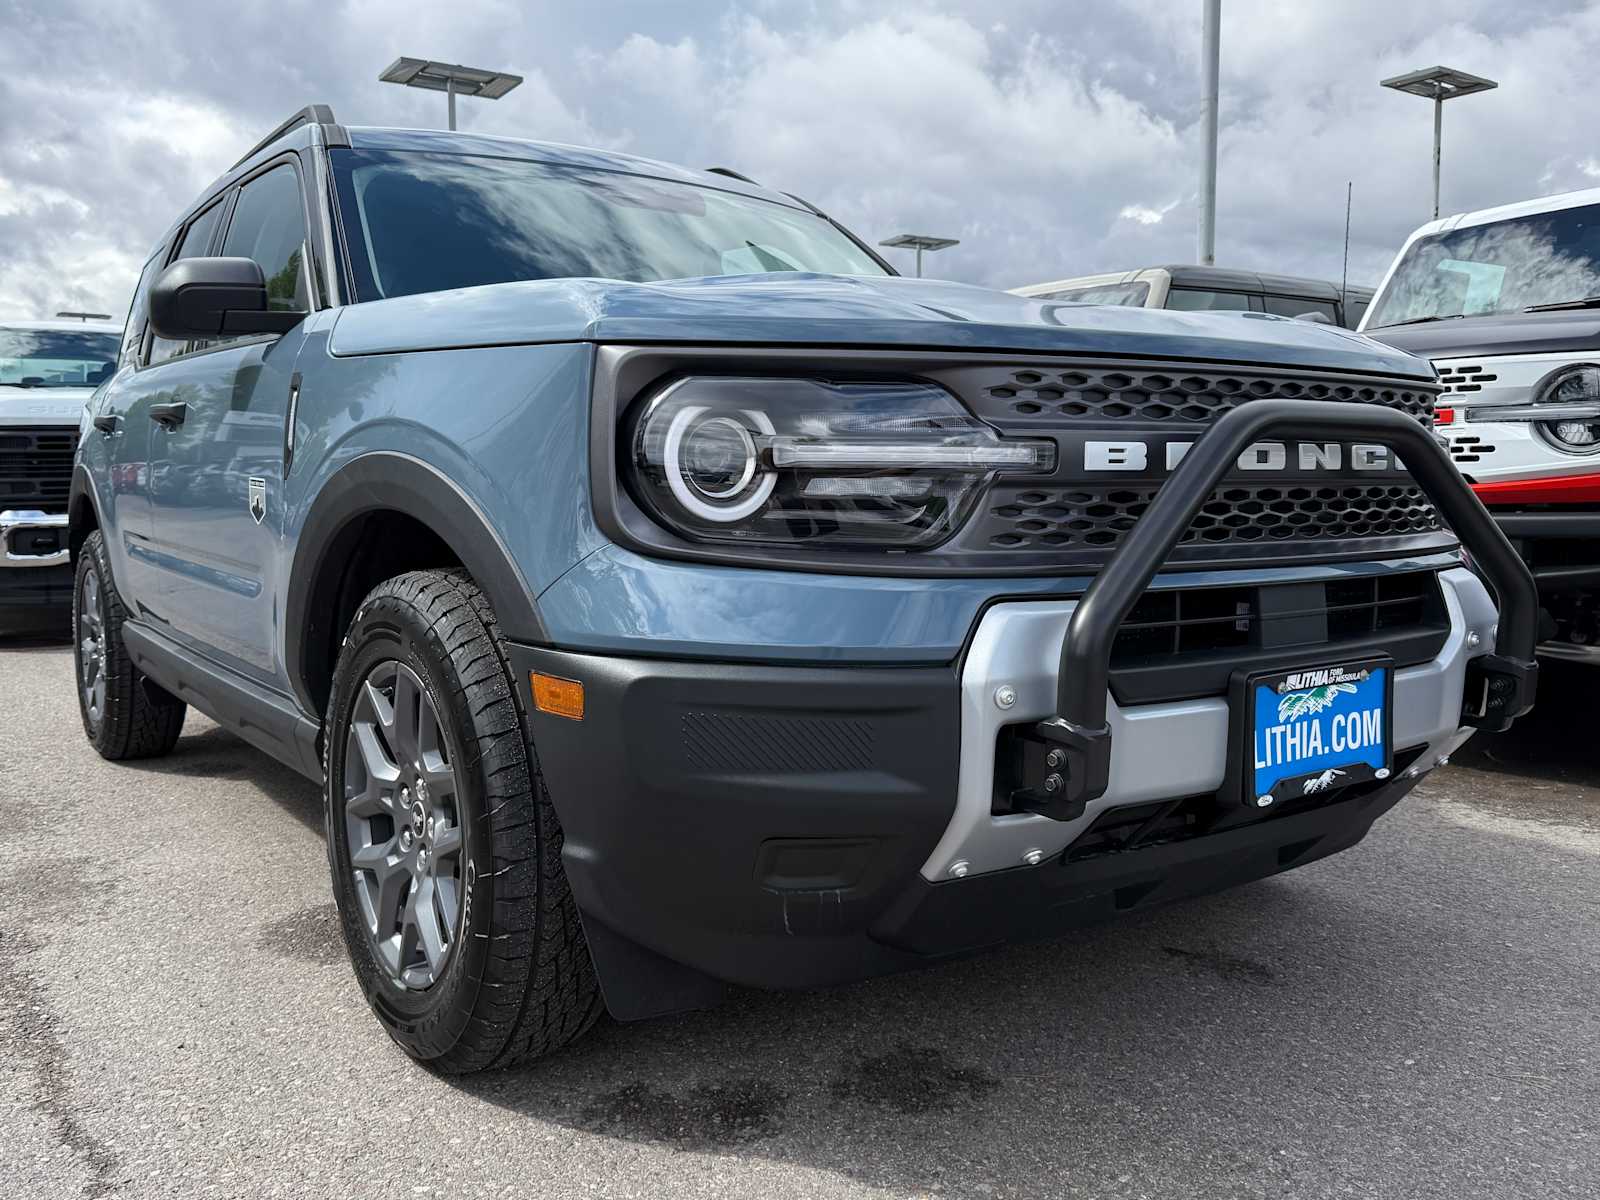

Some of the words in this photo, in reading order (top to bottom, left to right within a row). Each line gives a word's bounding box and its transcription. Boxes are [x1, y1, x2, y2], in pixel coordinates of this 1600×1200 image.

[1084, 441, 1407, 471] BONC
[1296, 670, 1329, 690] LITHIA
[1328, 676, 1336, 684] OF
[1335, 672, 1361, 683] MISSOULA
[1330, 668, 1344, 677] FORD
[1254, 708, 1381, 770] LITHIA.COM
